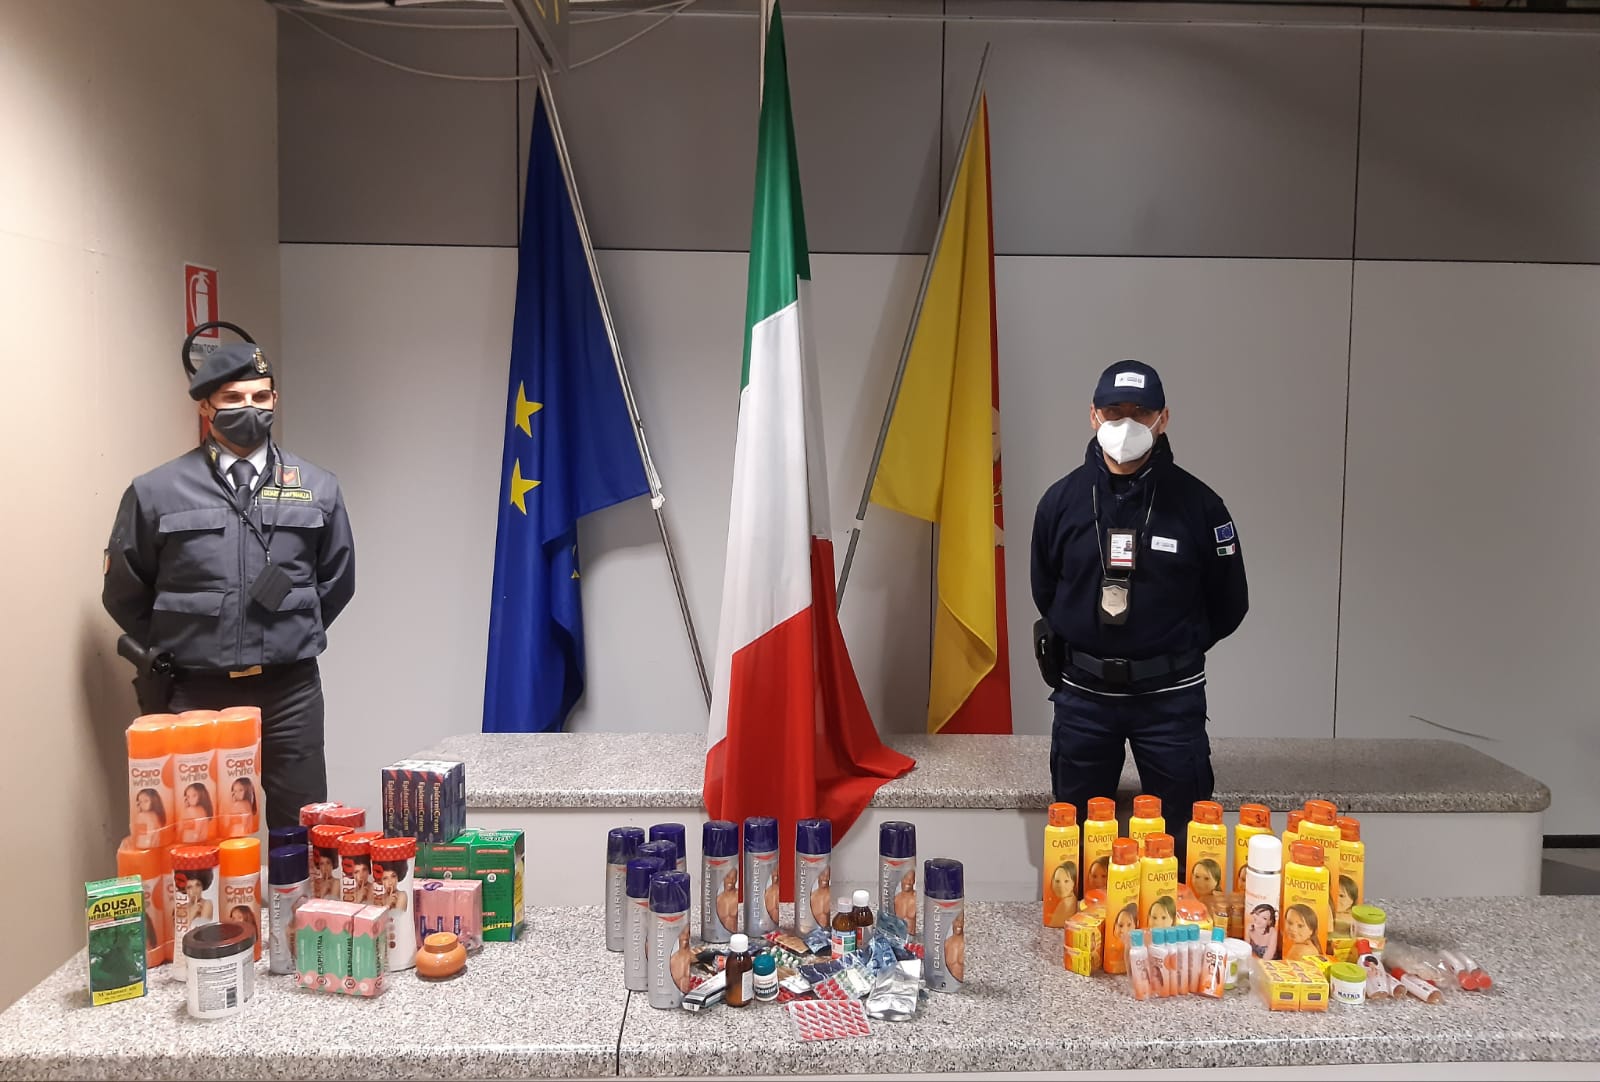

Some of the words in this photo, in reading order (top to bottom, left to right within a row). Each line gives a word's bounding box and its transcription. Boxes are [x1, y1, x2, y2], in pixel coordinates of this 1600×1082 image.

[179, 763, 208, 774] Caro
[226, 758, 253, 768] Caro
[131, 767, 160, 778] Caro
[1191, 835, 1227, 846] CAROTONE
[225, 885, 253, 895] Caro
[753, 859, 761, 918] CLAIRMEN
[1286, 877, 1327, 892] CAROTONE
[704, 863, 712, 924] CLAIRMEN
[88, 911, 112, 921] HERBAL
[113, 906, 142, 917] MIXTURE
[92, 897, 137, 915] ADUSA
[175, 889, 189, 933] SECRE
[933, 905, 942, 969] CLAIRMEN
[657, 921, 665, 987] CLAIRMEN
